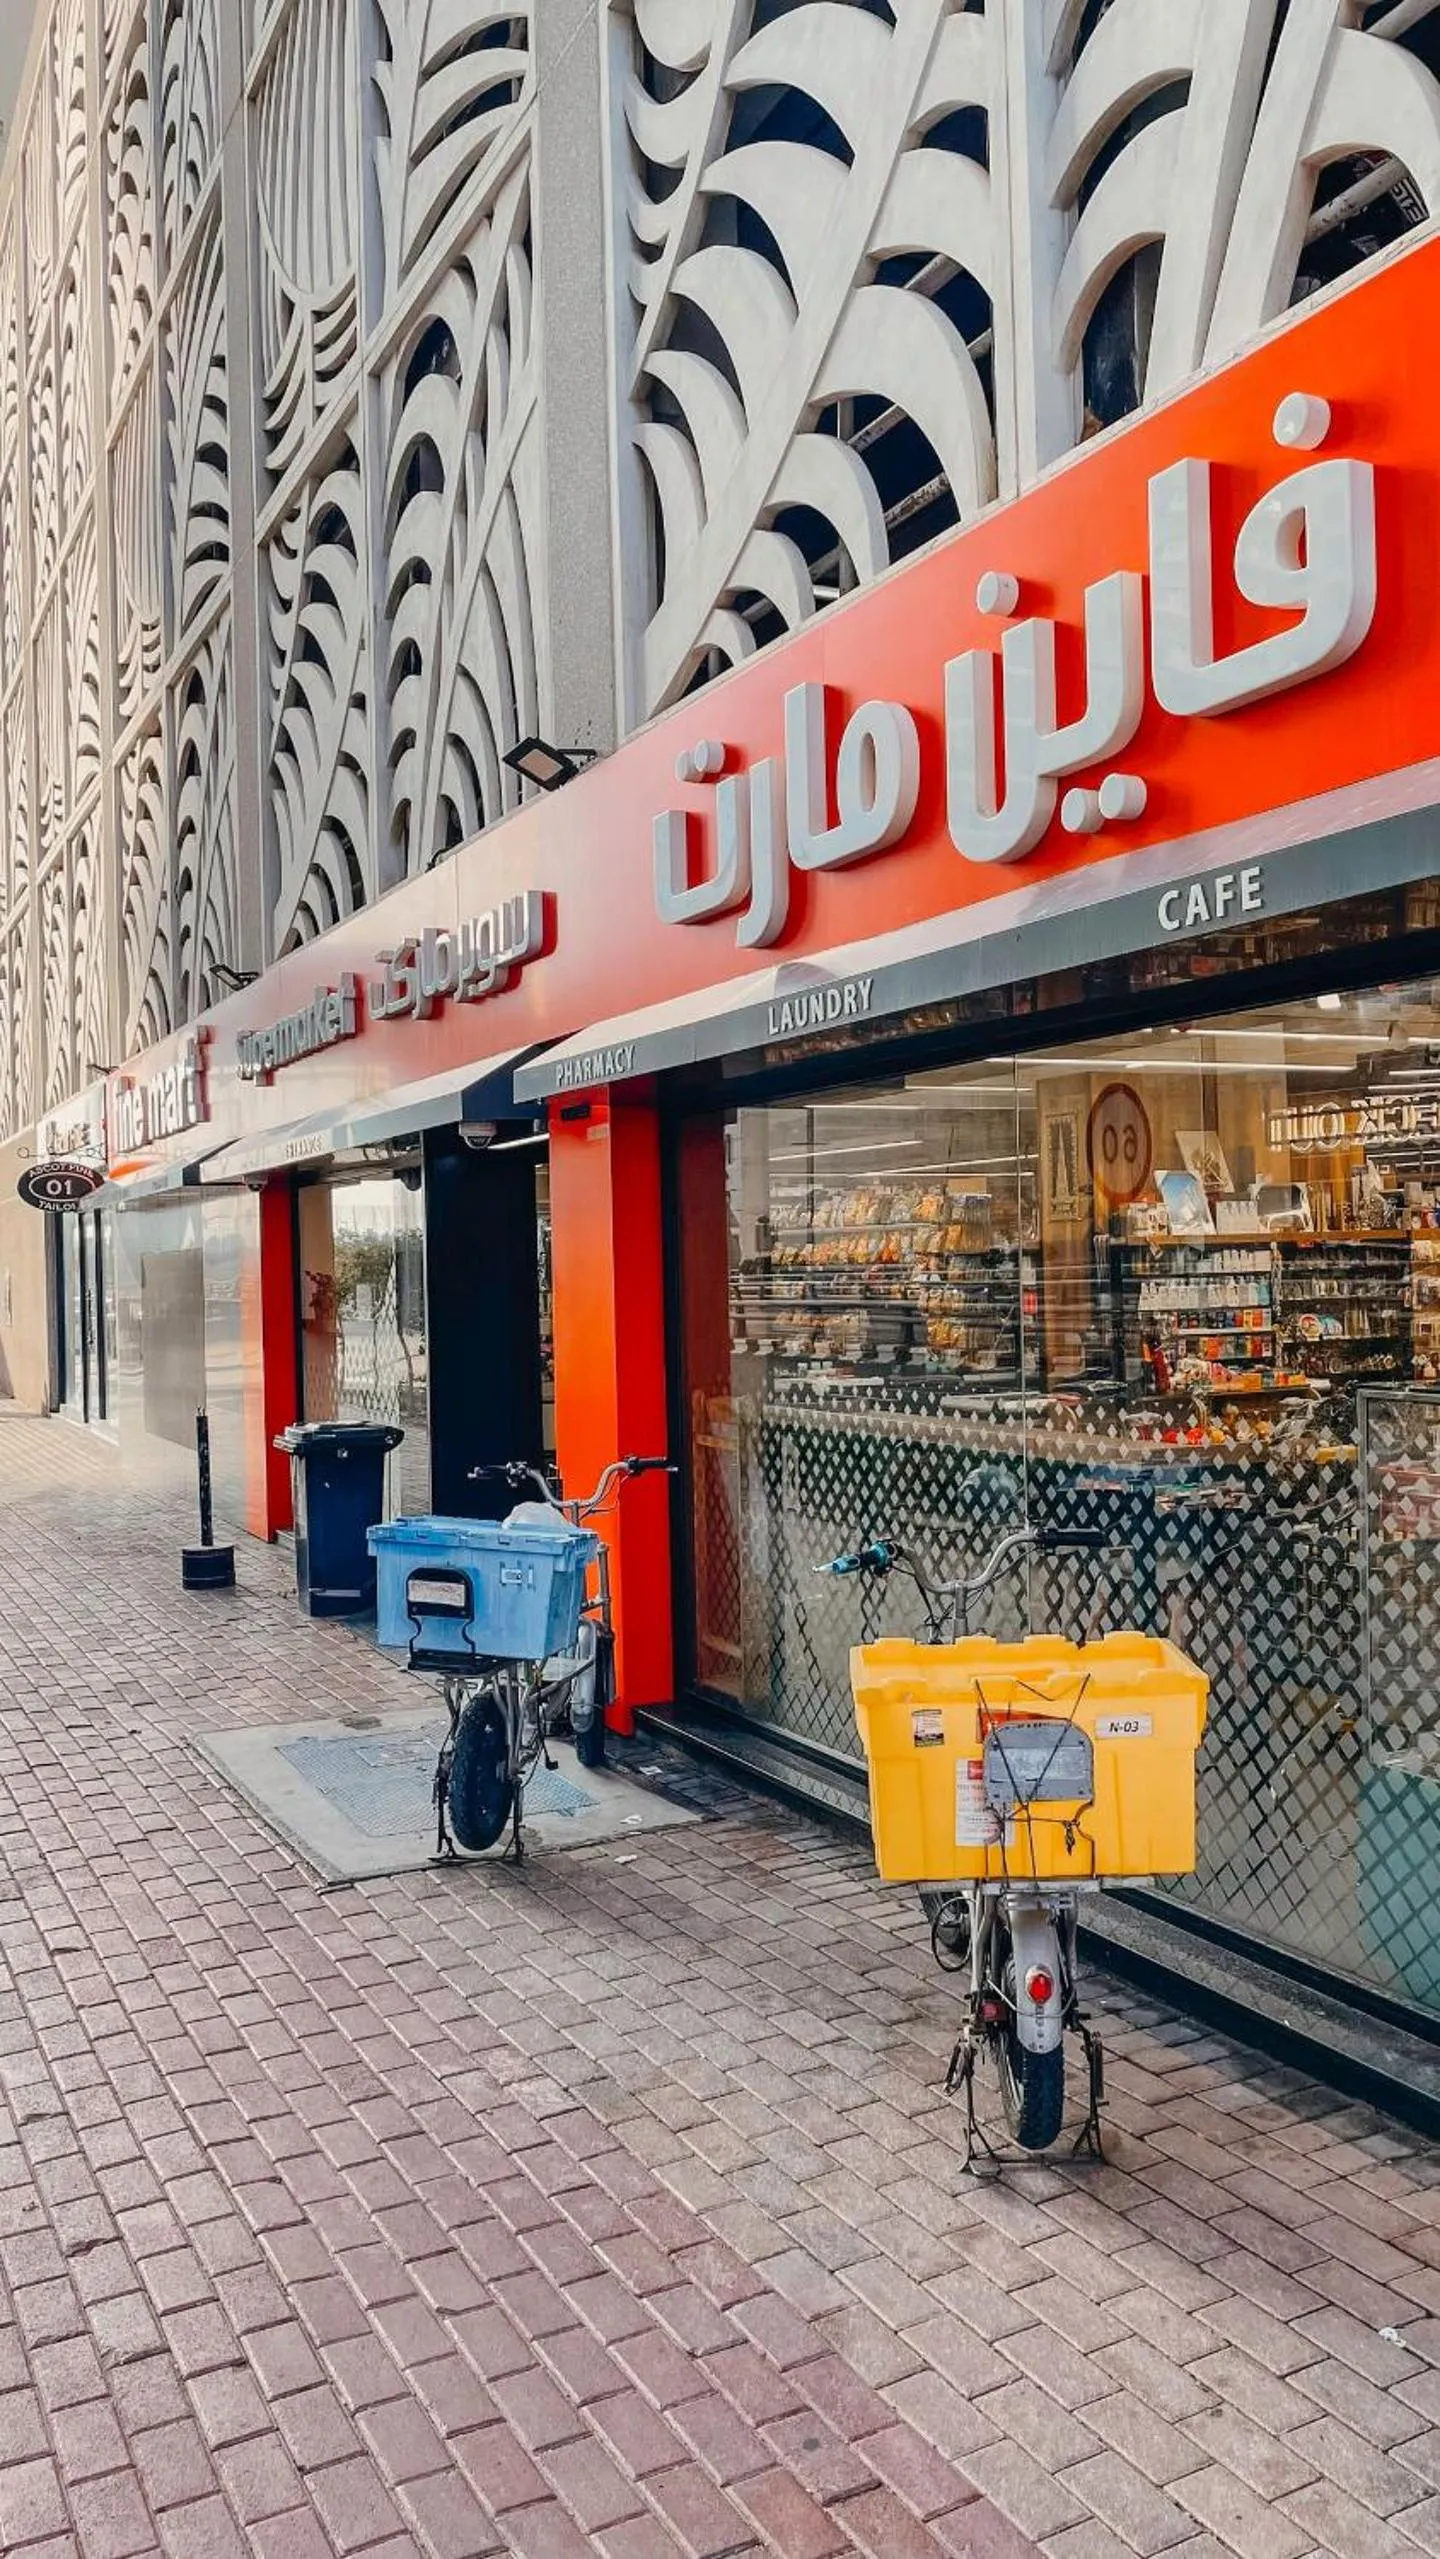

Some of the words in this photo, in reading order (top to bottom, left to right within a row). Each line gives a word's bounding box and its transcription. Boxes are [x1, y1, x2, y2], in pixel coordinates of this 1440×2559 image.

[945, 392, 1379, 862] فاين
[653, 681, 920, 948] مارت
[1158, 866, 1262, 931] CAFE
[768, 979, 874, 1036] LAUNDRY
[556, 1046, 636, 1088] PHARMACY
[46, 1180, 72, 1195] 01
[1109, 1721, 1139, 1733] N-03
